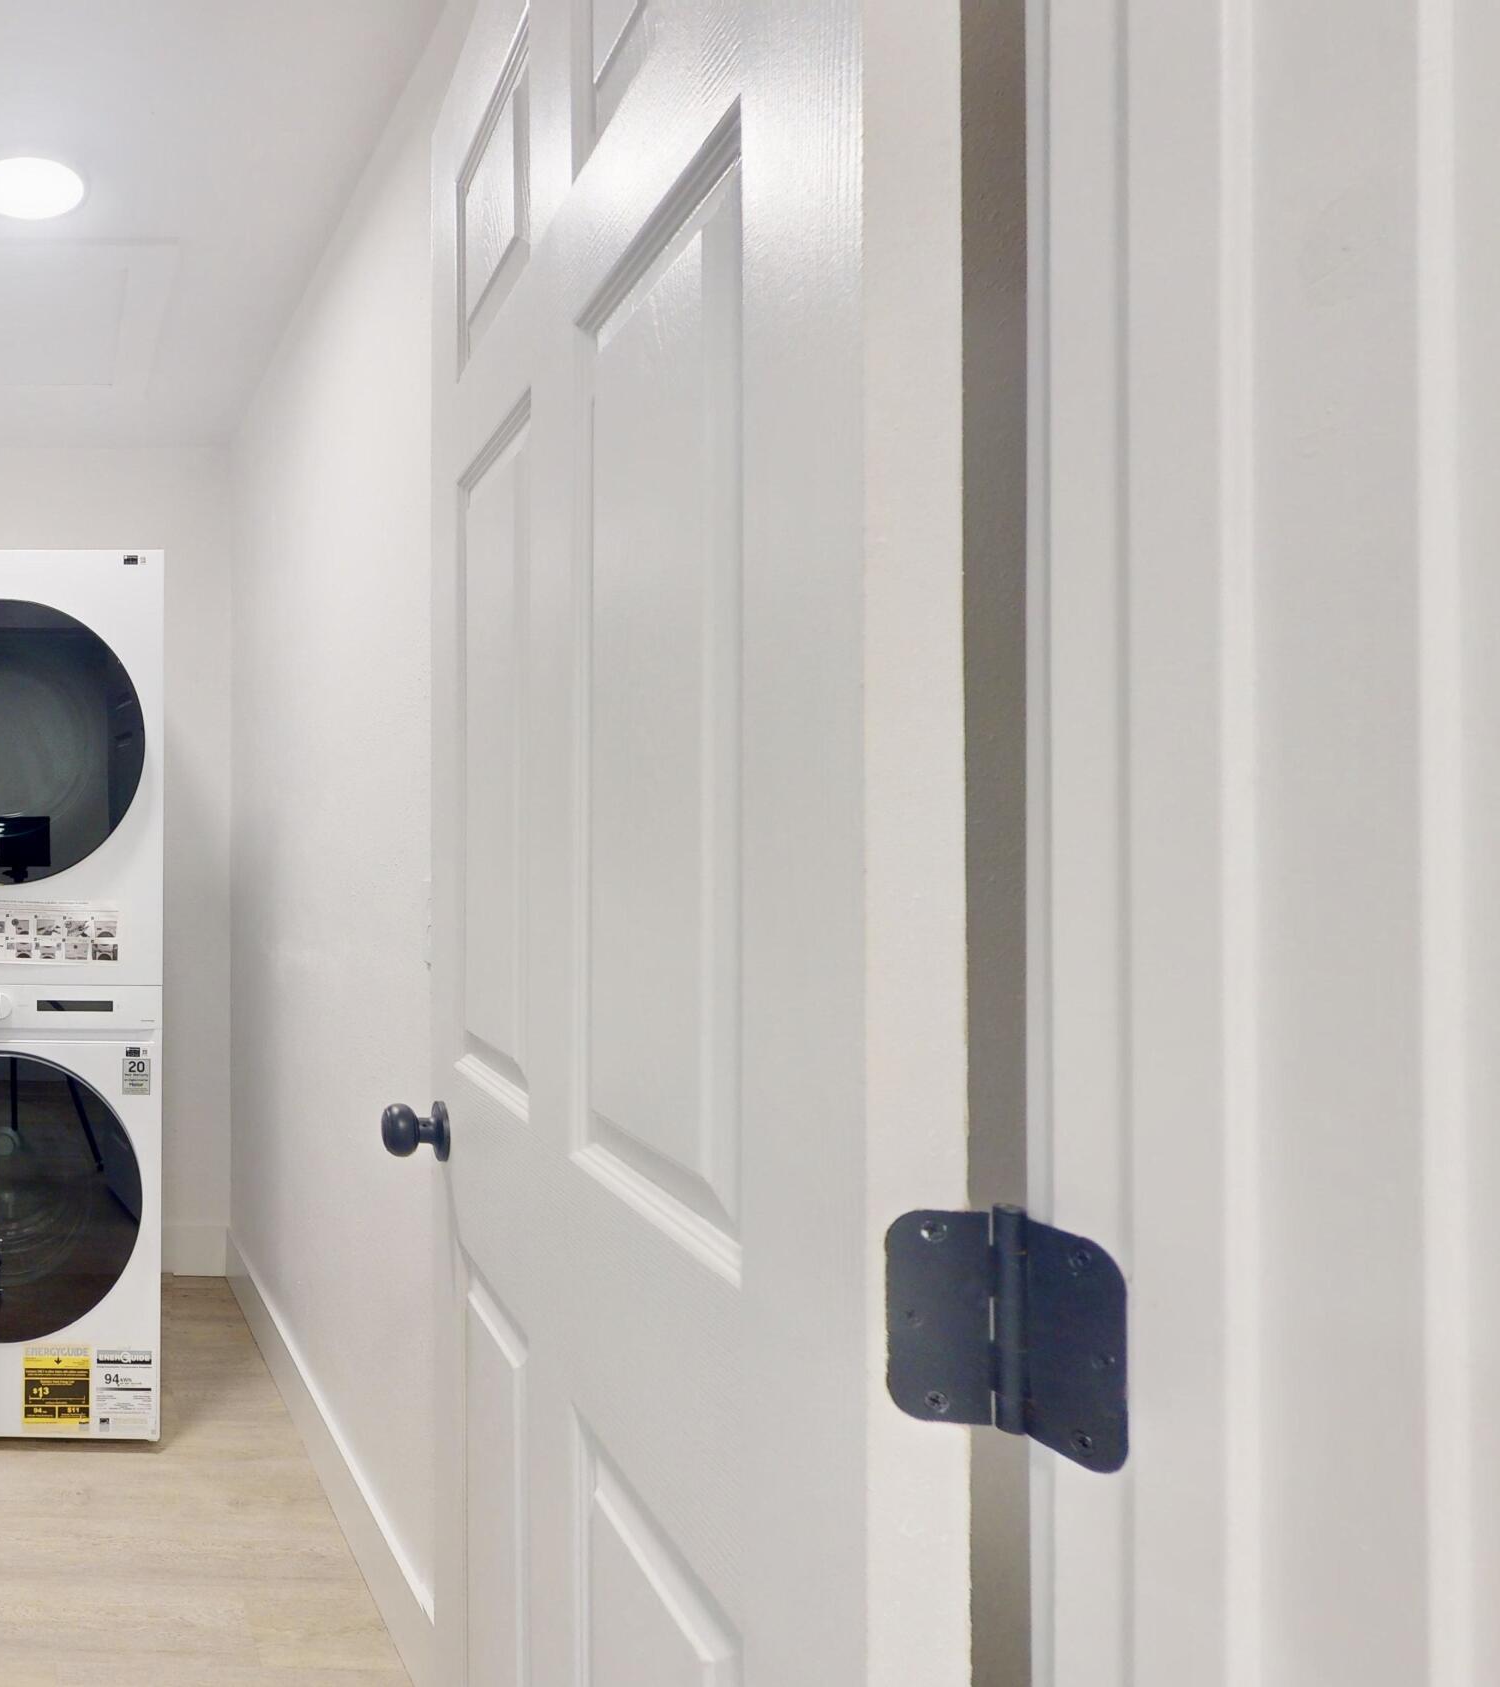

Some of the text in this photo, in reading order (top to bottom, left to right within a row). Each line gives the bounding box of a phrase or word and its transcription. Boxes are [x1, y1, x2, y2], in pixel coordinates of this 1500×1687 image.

[128, 1060, 145, 1073] 20
[25, 1347, 89, 1356] ENERGYGUIDE
[99, 1351, 150, 1363] ENERGUIDE
[104, 1373, 119, 1385] 94
